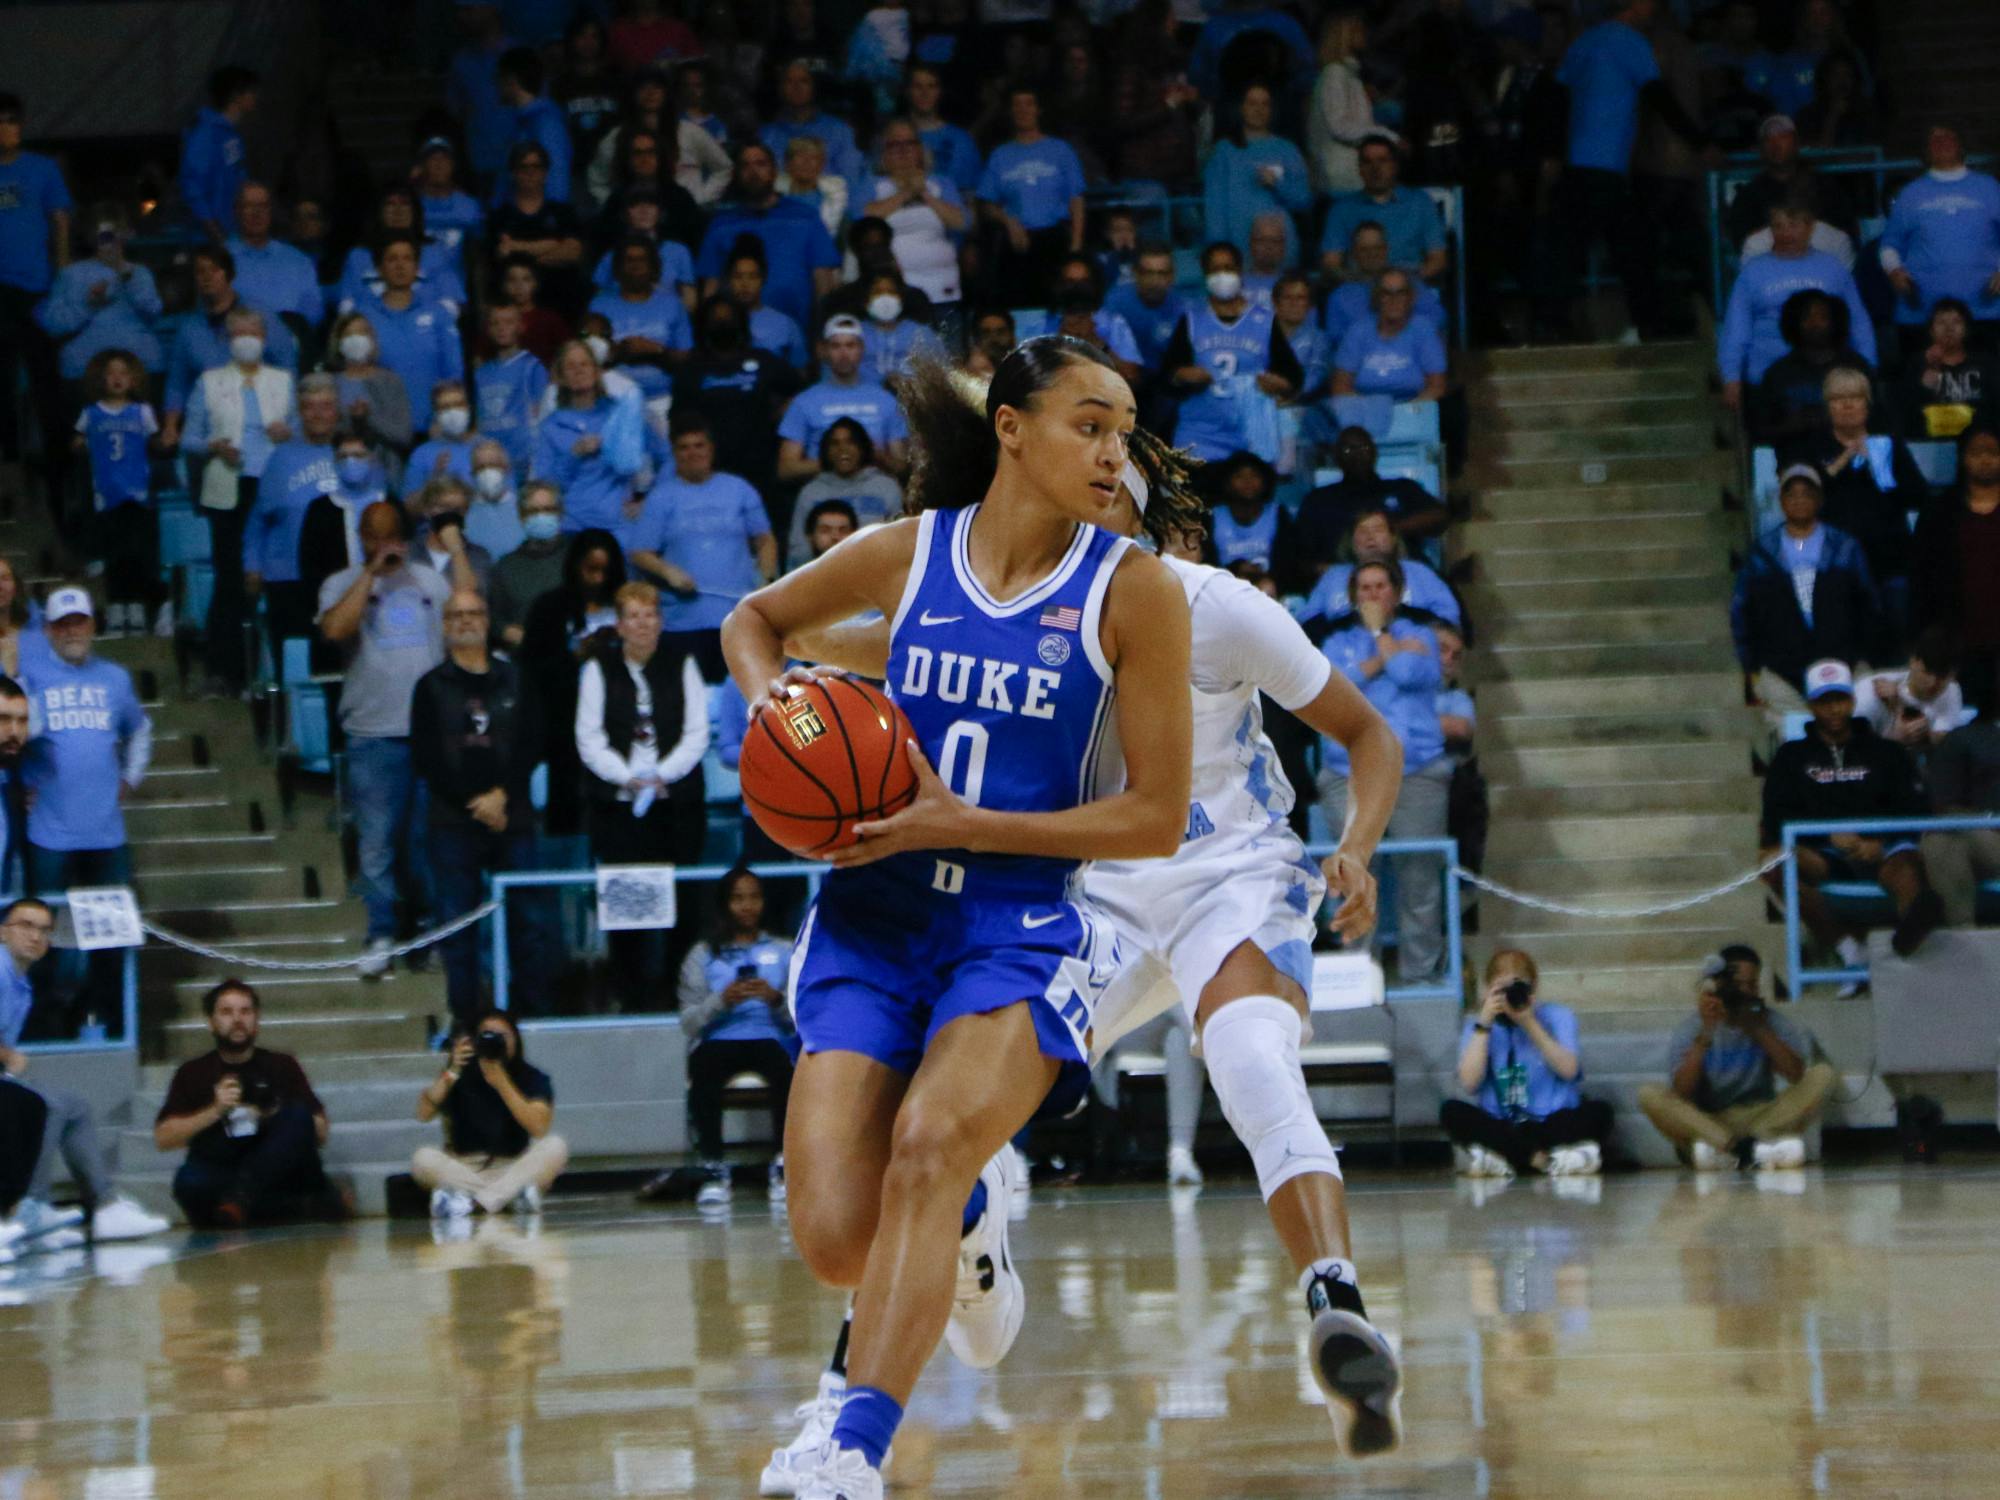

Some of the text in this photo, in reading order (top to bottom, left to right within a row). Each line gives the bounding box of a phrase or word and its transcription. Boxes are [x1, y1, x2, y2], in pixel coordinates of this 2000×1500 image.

[44, 686, 107, 709] BEAT
[902, 645, 1061, 720] DUKE
[47, 709, 112, 732] DOOK
[938, 719, 989, 808] 0
[931, 858, 965, 894] D
